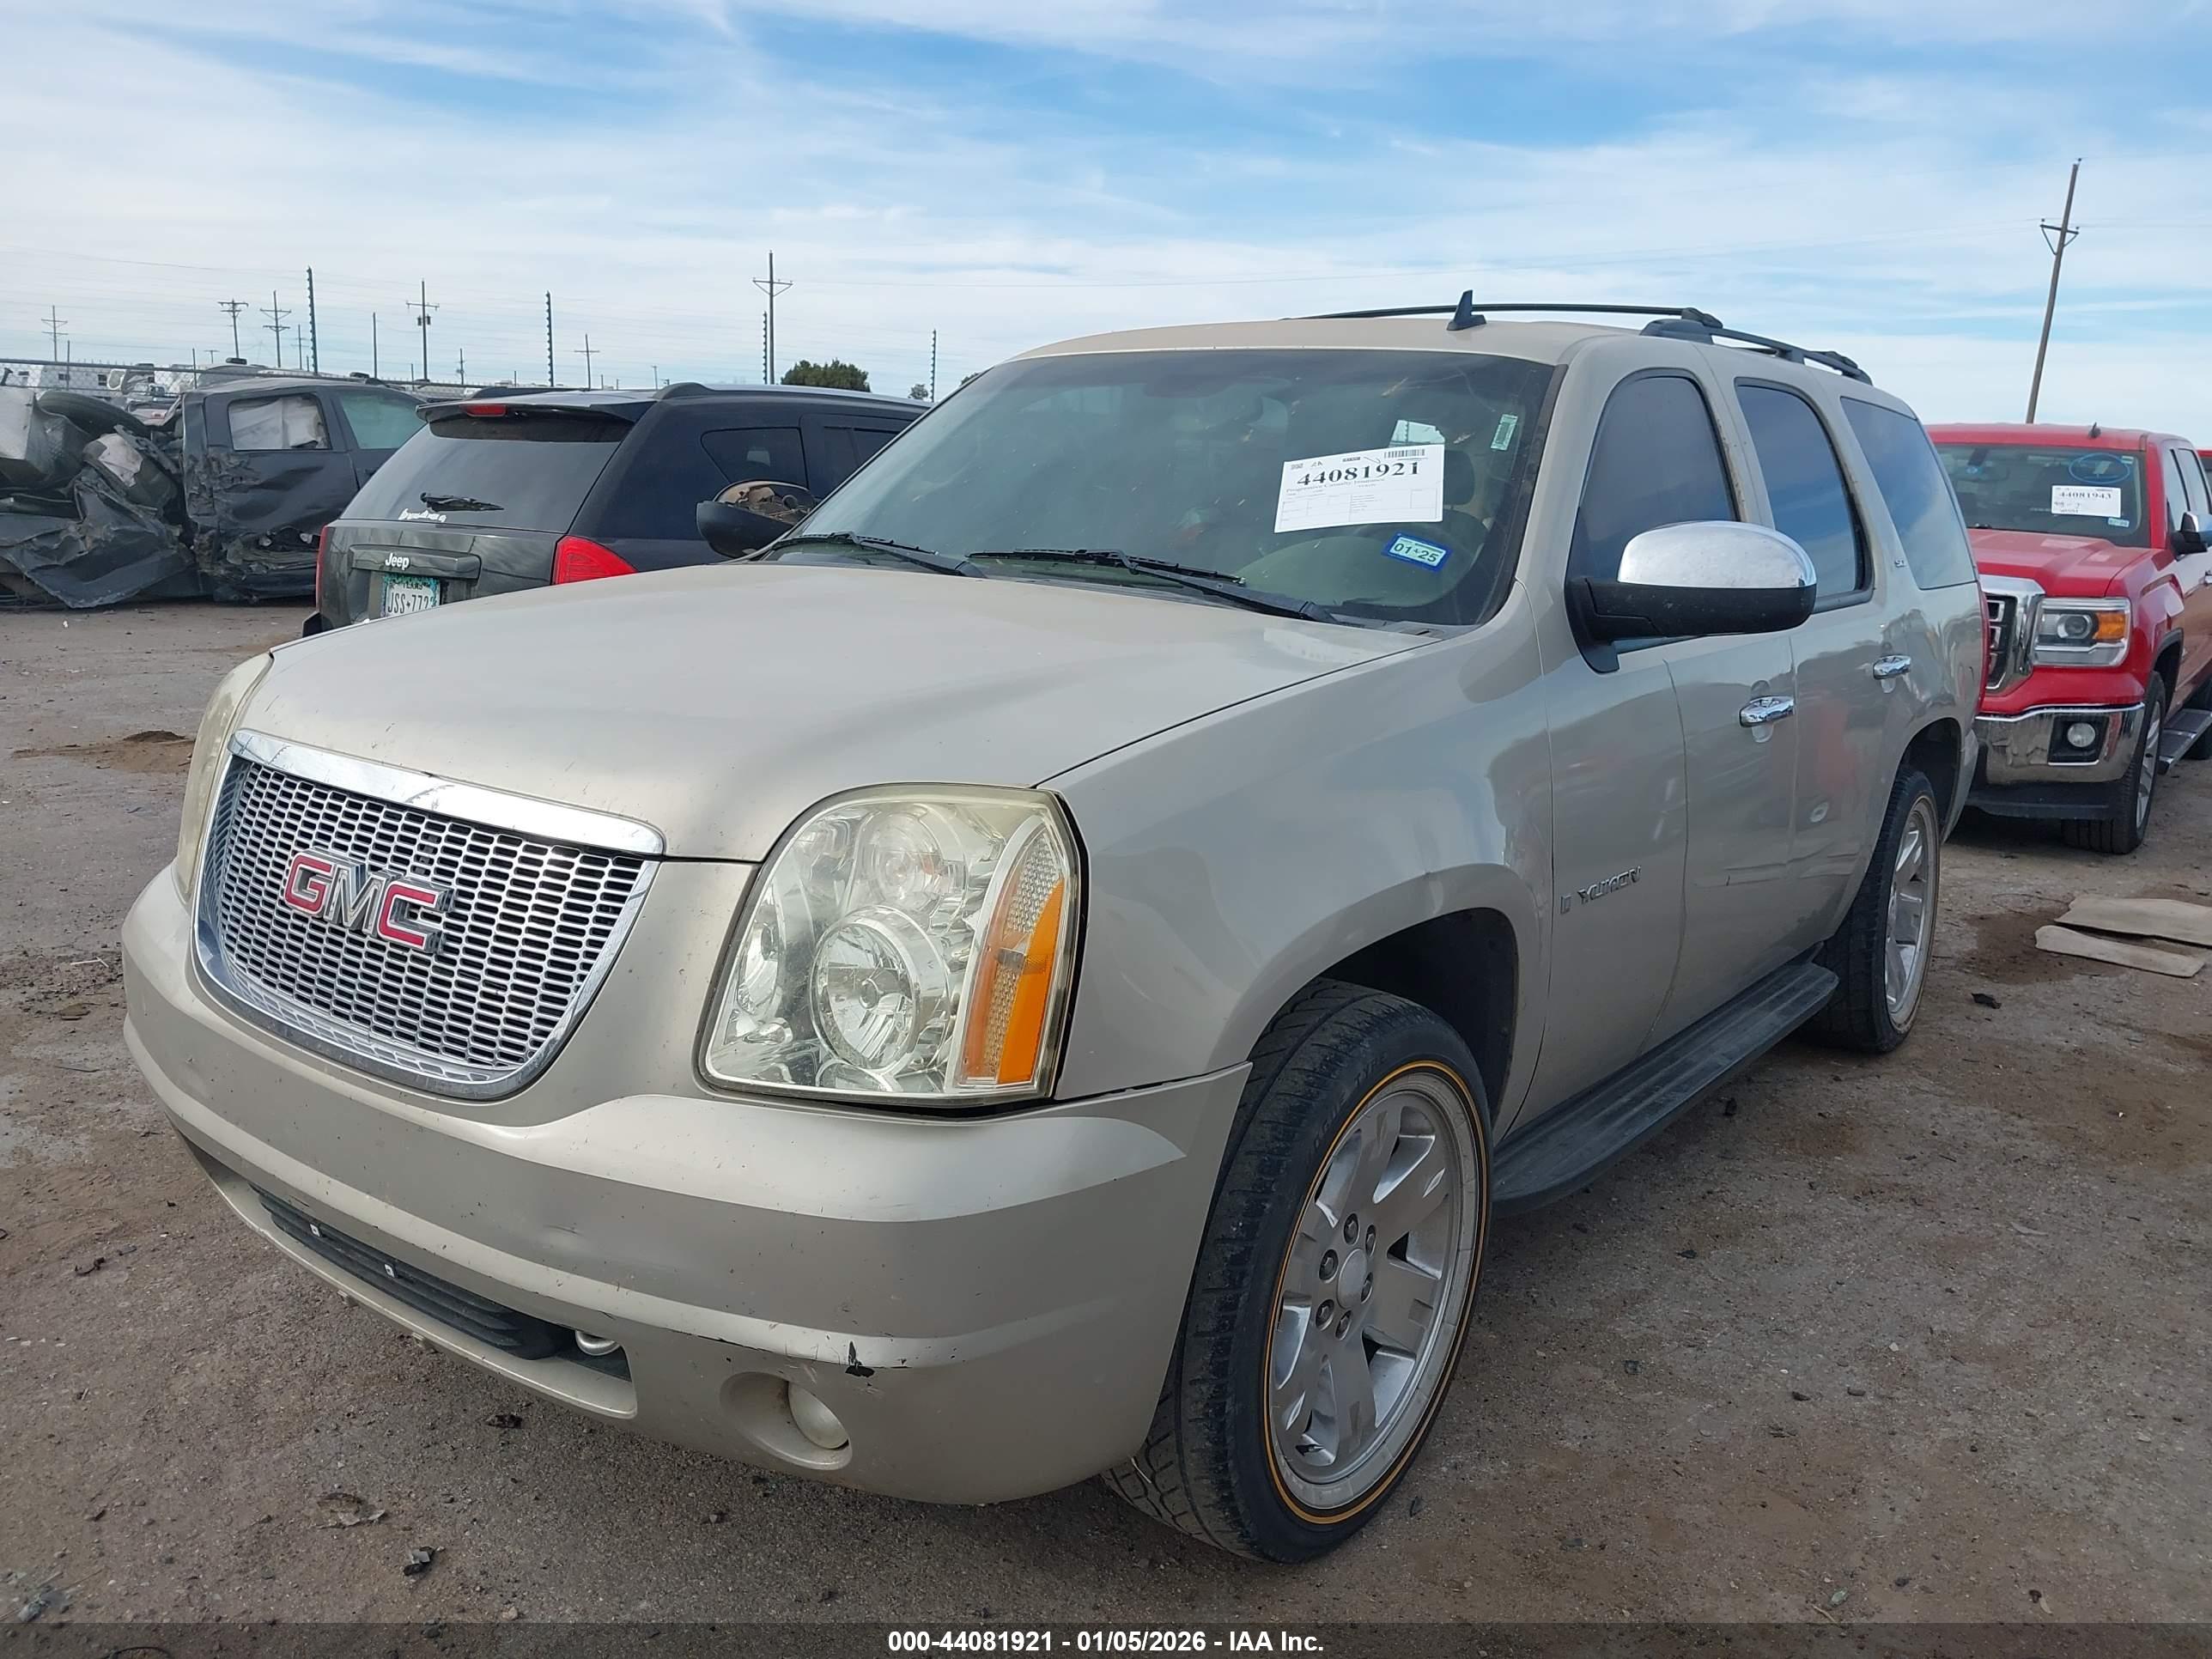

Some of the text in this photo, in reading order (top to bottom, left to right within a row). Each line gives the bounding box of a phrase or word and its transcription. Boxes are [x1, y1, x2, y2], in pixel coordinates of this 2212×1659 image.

[1297, 461, 1420, 486] 44081921
[385, 552, 410, 571] Jeep
[284, 851, 441, 951] GMC
